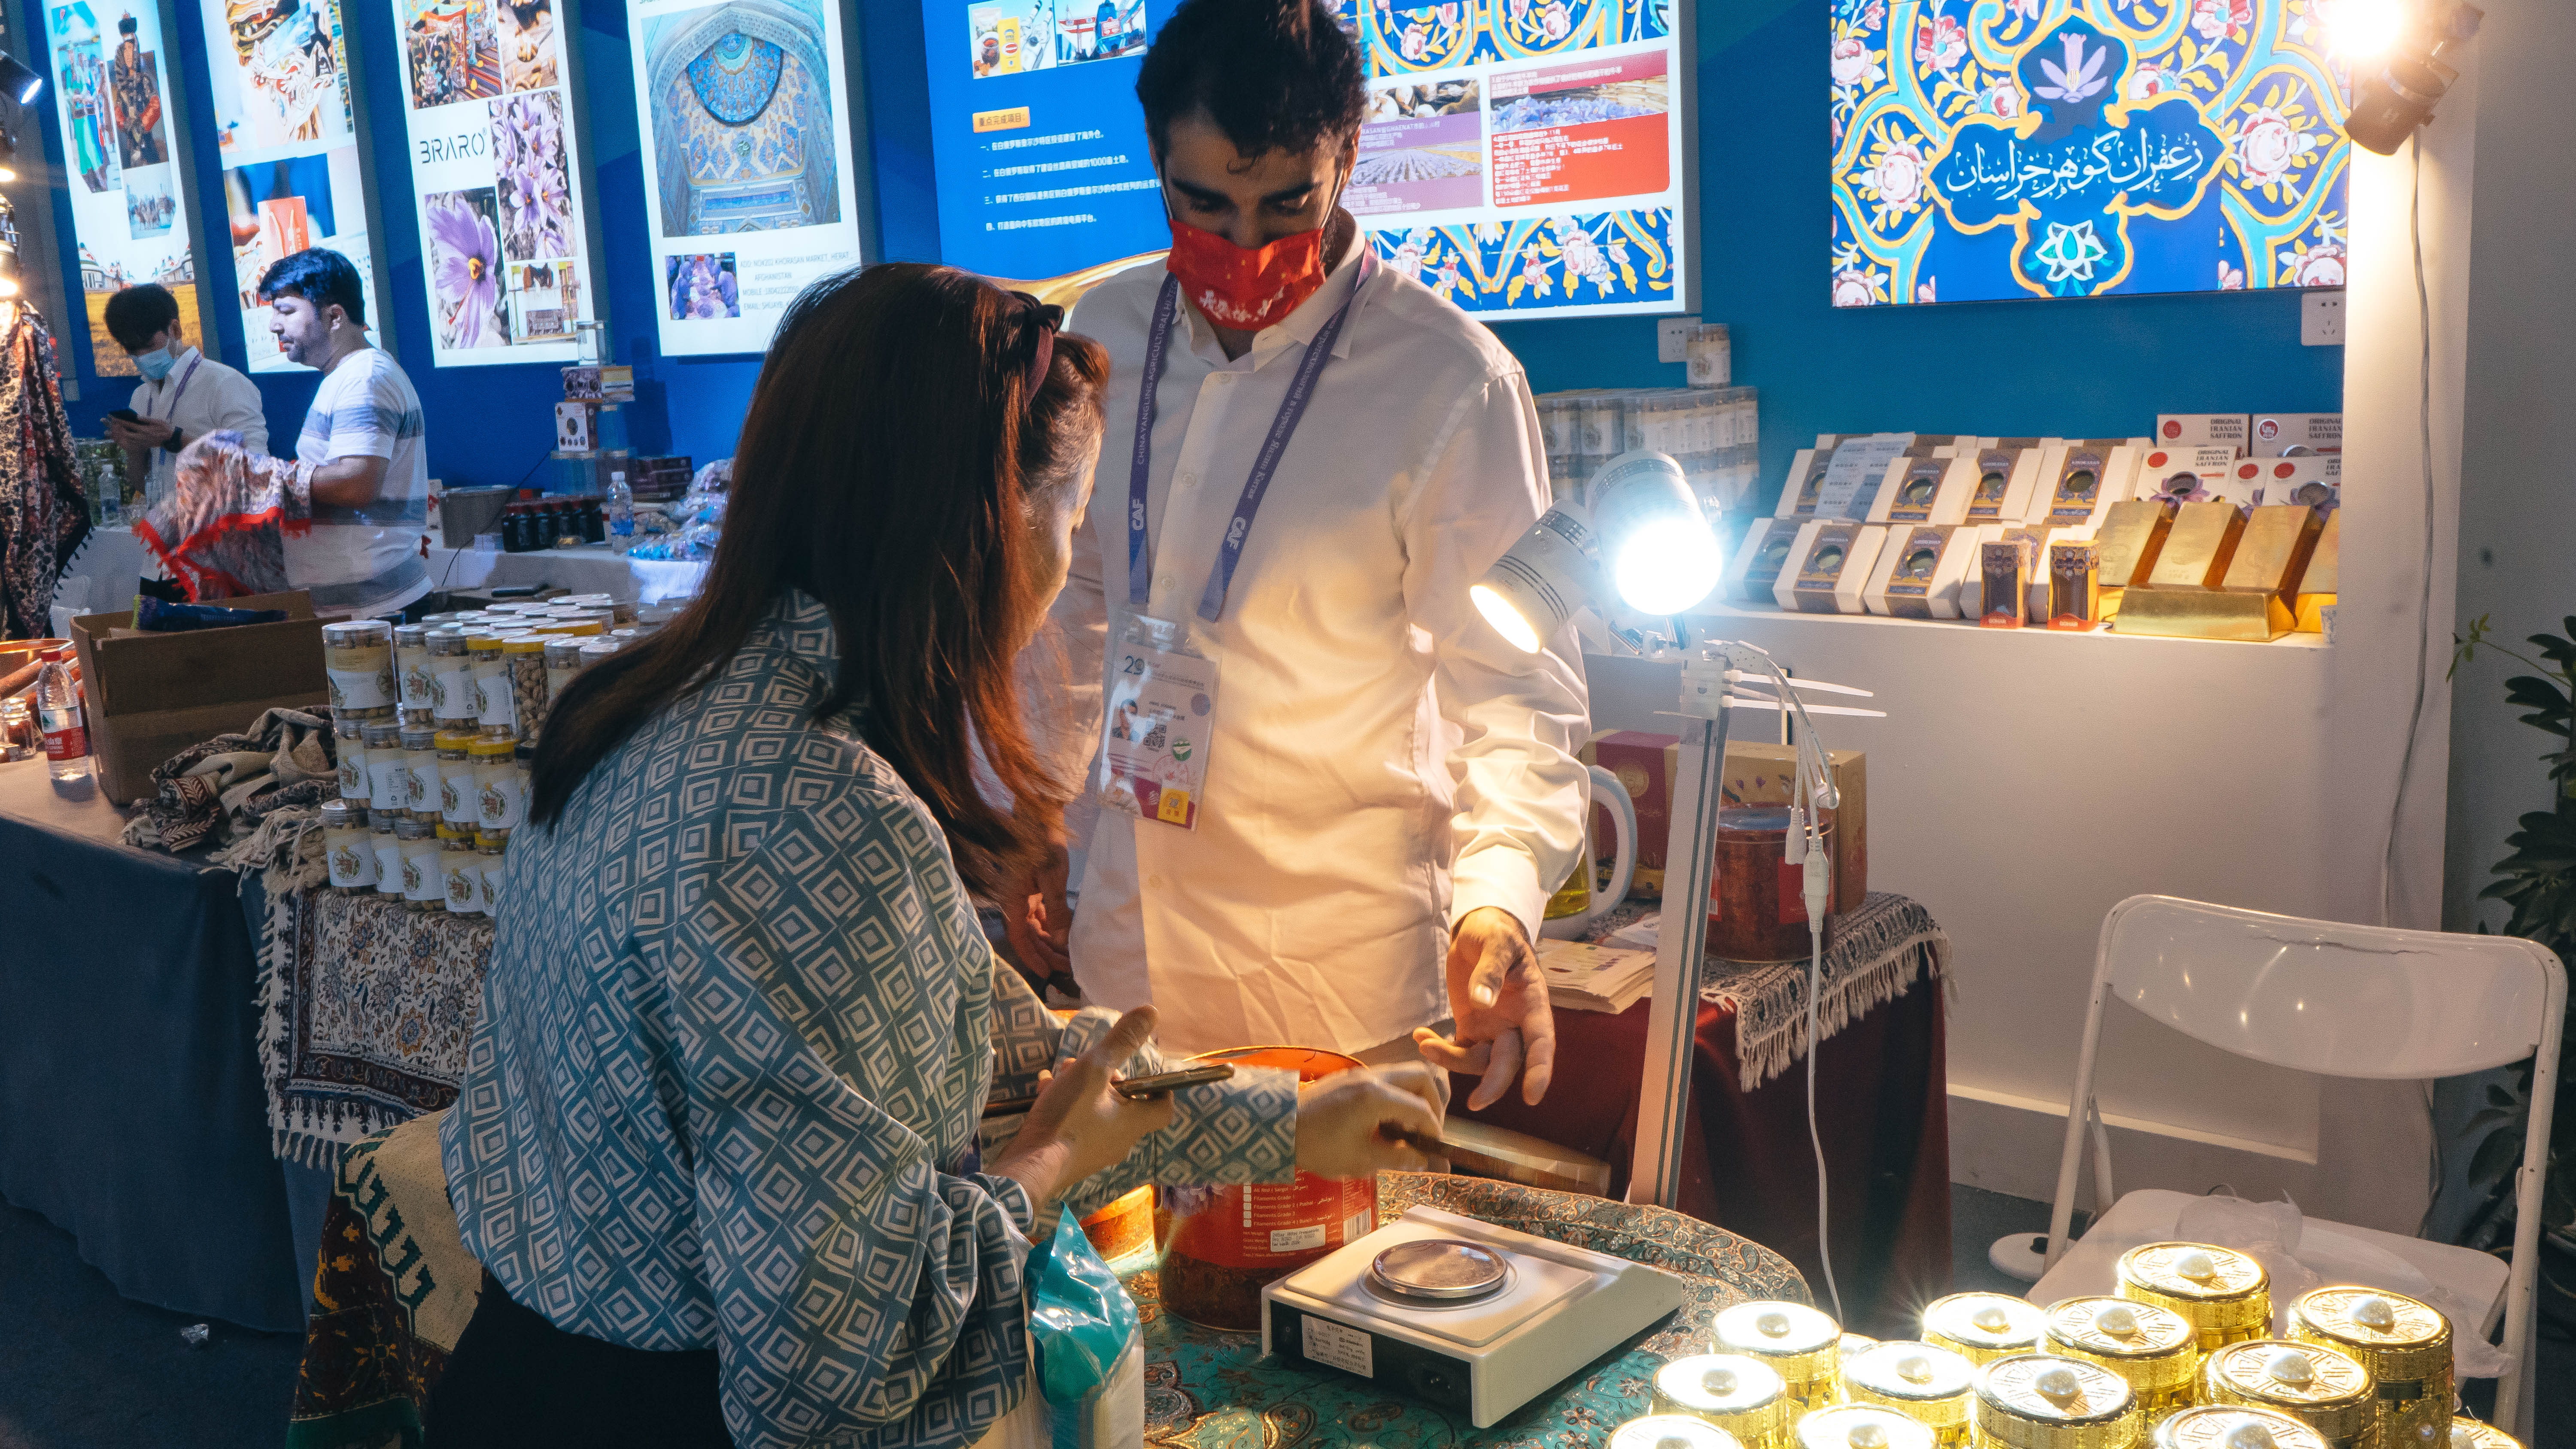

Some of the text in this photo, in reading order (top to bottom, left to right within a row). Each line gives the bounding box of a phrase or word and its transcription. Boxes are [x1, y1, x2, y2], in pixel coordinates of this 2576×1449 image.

[419, 133, 485, 164] BRARO
[754, 272, 792, 281] AFGHANISTAN
[1147, 312, 1170, 381] AGRICULTURAL
[1140, 382, 1152, 433] YANGLING
[1138, 433, 1146, 464] CHINA
